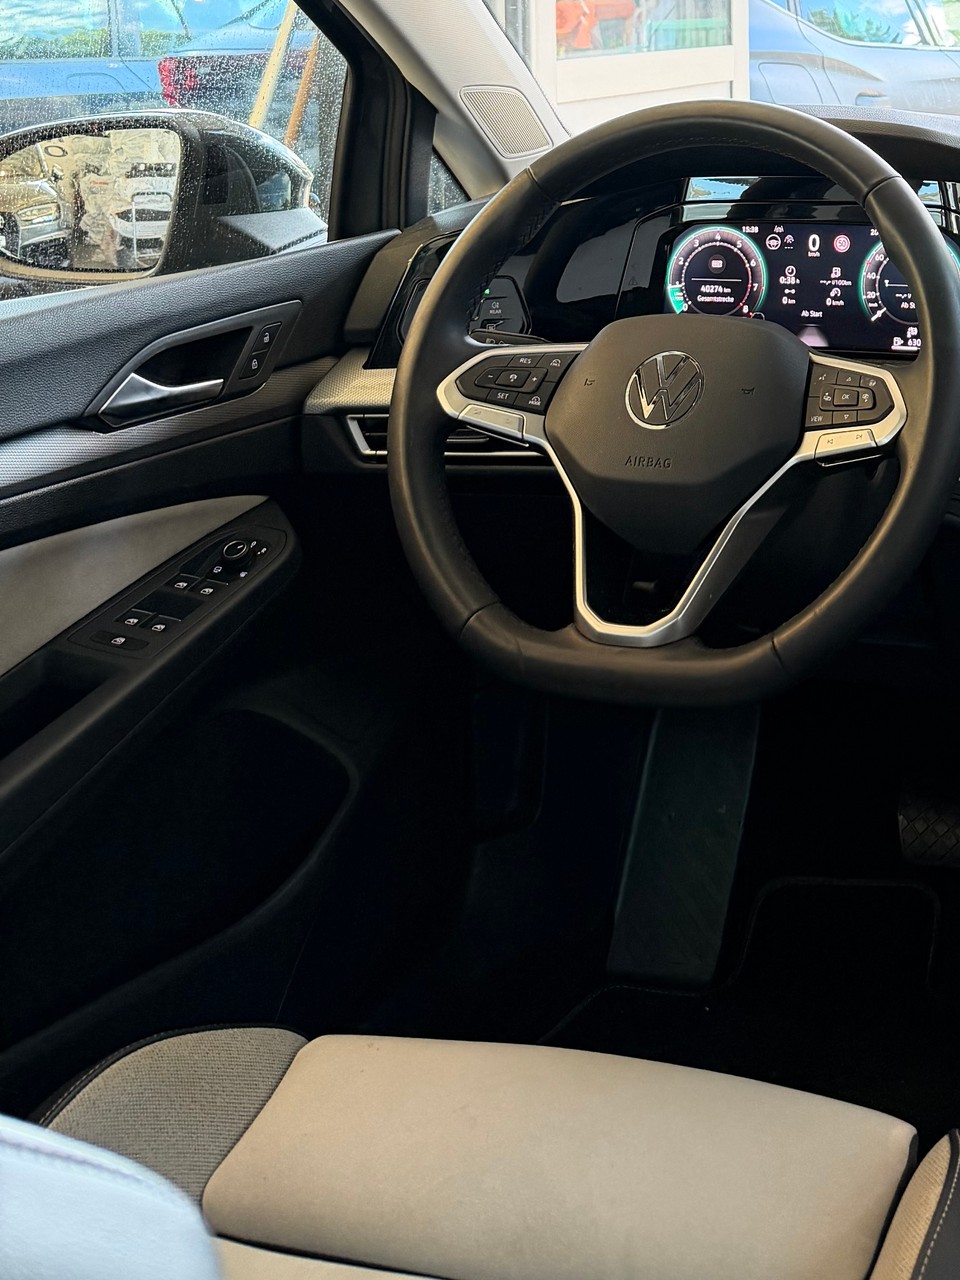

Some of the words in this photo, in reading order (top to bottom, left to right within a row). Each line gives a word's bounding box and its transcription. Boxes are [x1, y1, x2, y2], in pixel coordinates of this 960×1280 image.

[715, 233, 721, 241] 4
[809, 234, 820, 251] 0
[679, 257, 684, 265] 2
[701, 285, 723, 293] 40274
[753, 283, 758, 291] 7
[697, 295, 734, 303] Gesamtstrecke
[866, 291, 876, 299] 20
[826, 297, 831, 306] 0
[743, 305, 748, 313] 8
[625, 455, 672, 469] AIRBAG
